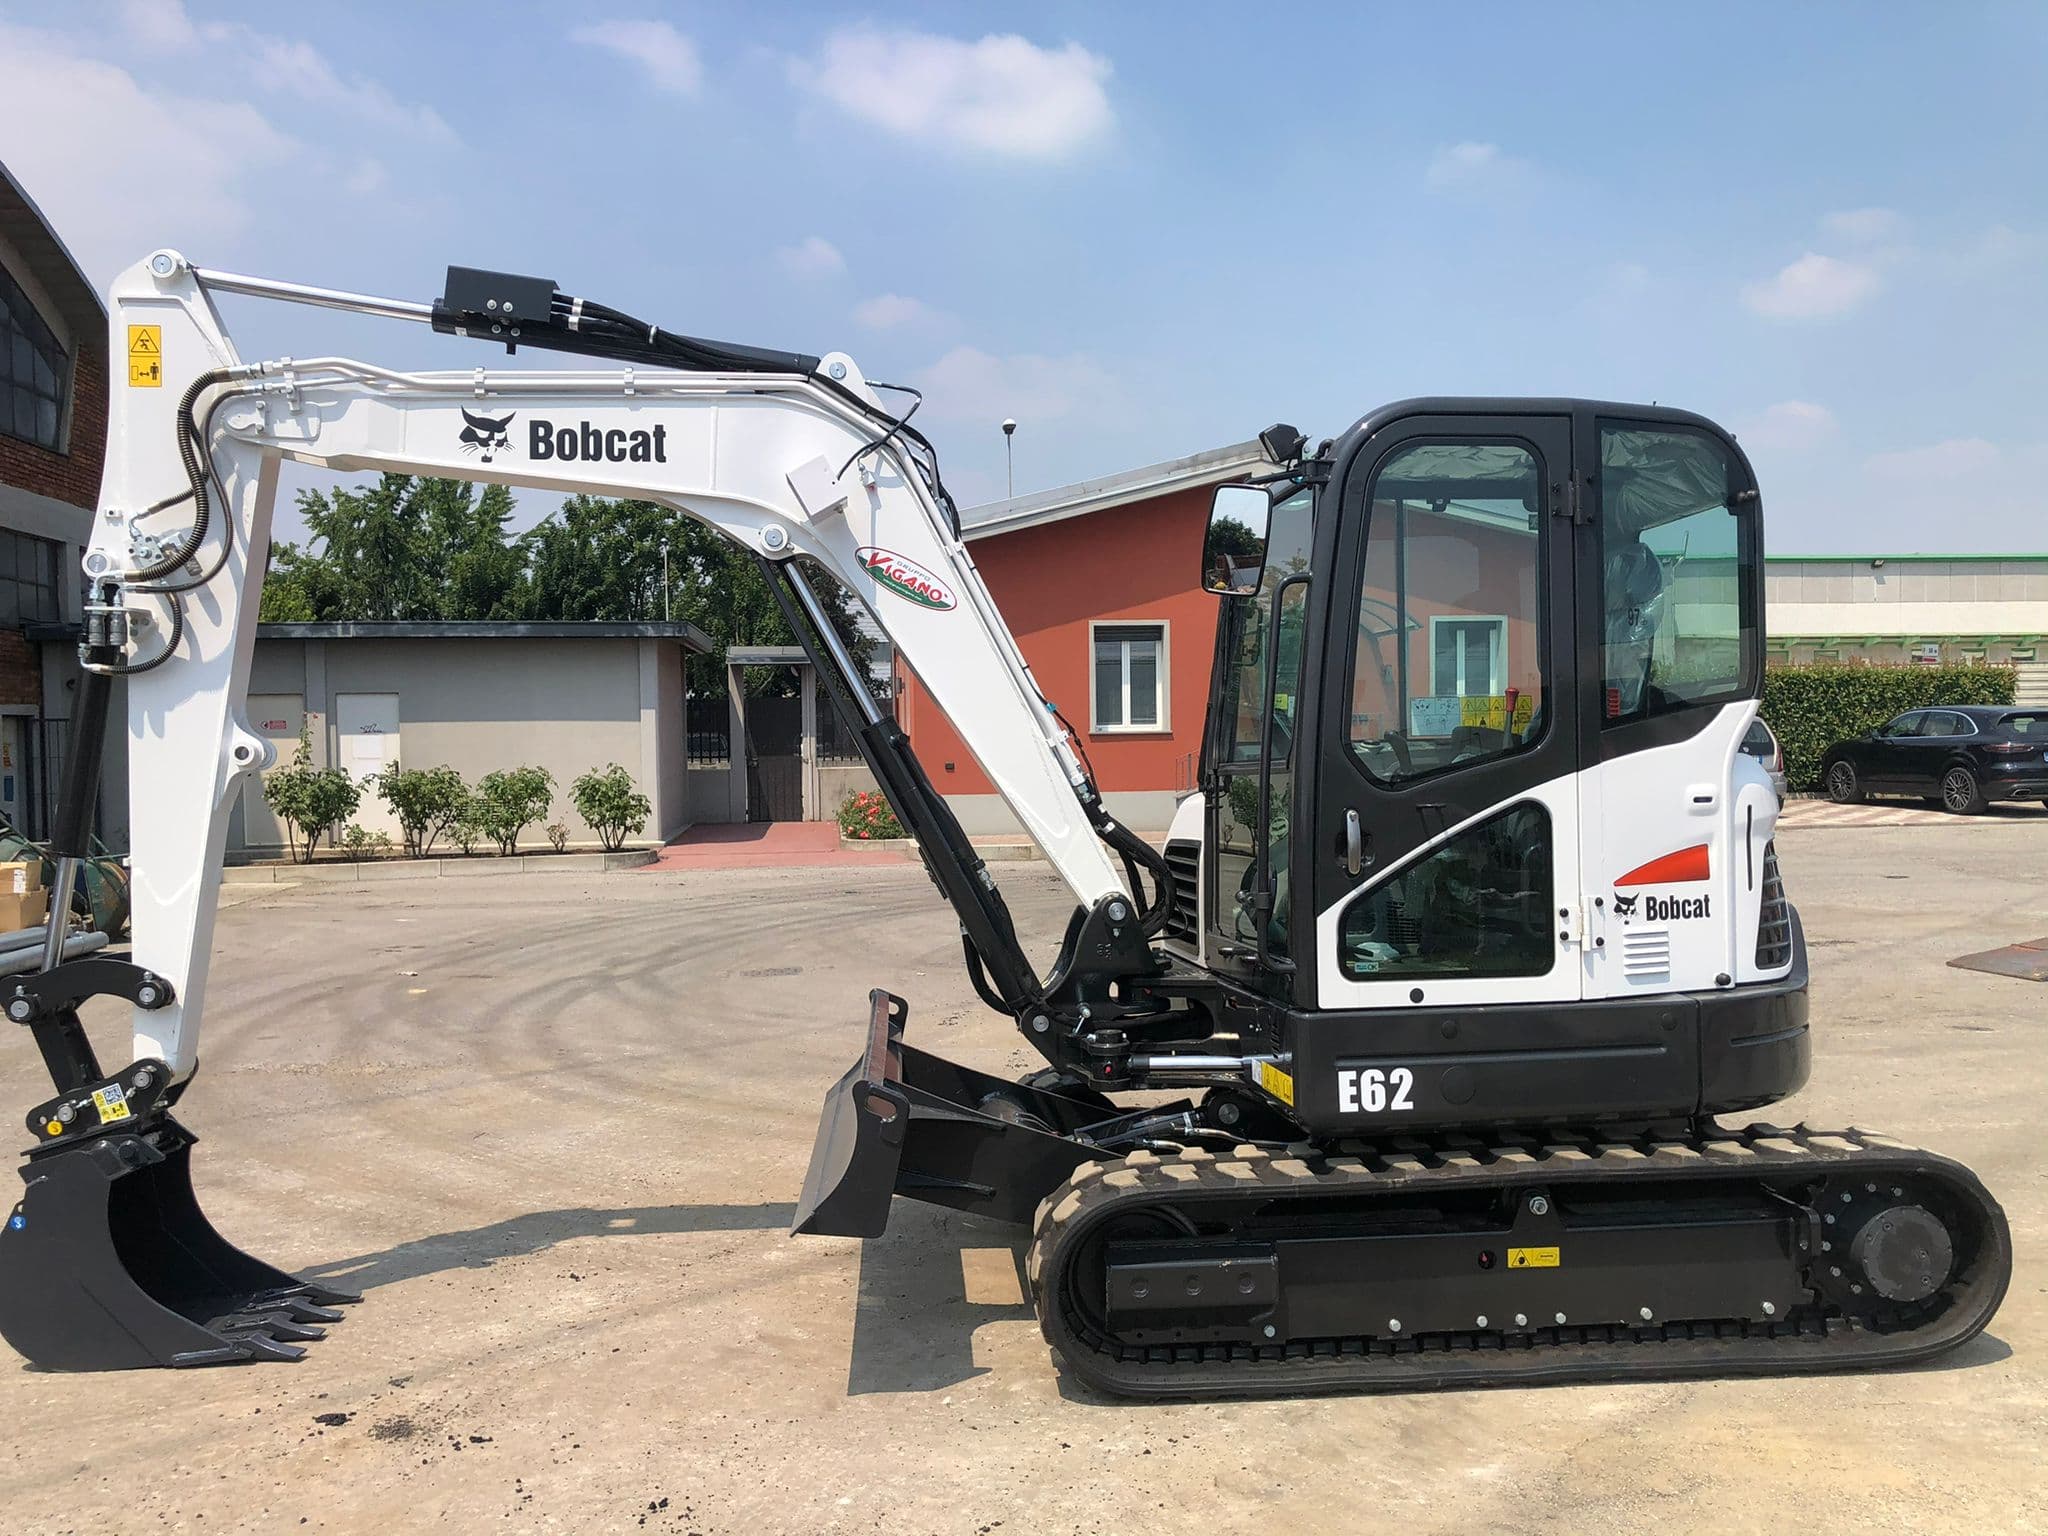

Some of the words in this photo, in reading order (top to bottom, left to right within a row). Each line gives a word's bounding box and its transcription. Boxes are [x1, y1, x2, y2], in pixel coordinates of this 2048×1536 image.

[529, 420, 667, 463] Bobcat
[896, 560, 931, 582] GRUPPO
[1645, 894, 1711, 921] Bobcat
[1338, 1067, 1414, 1113] E62
